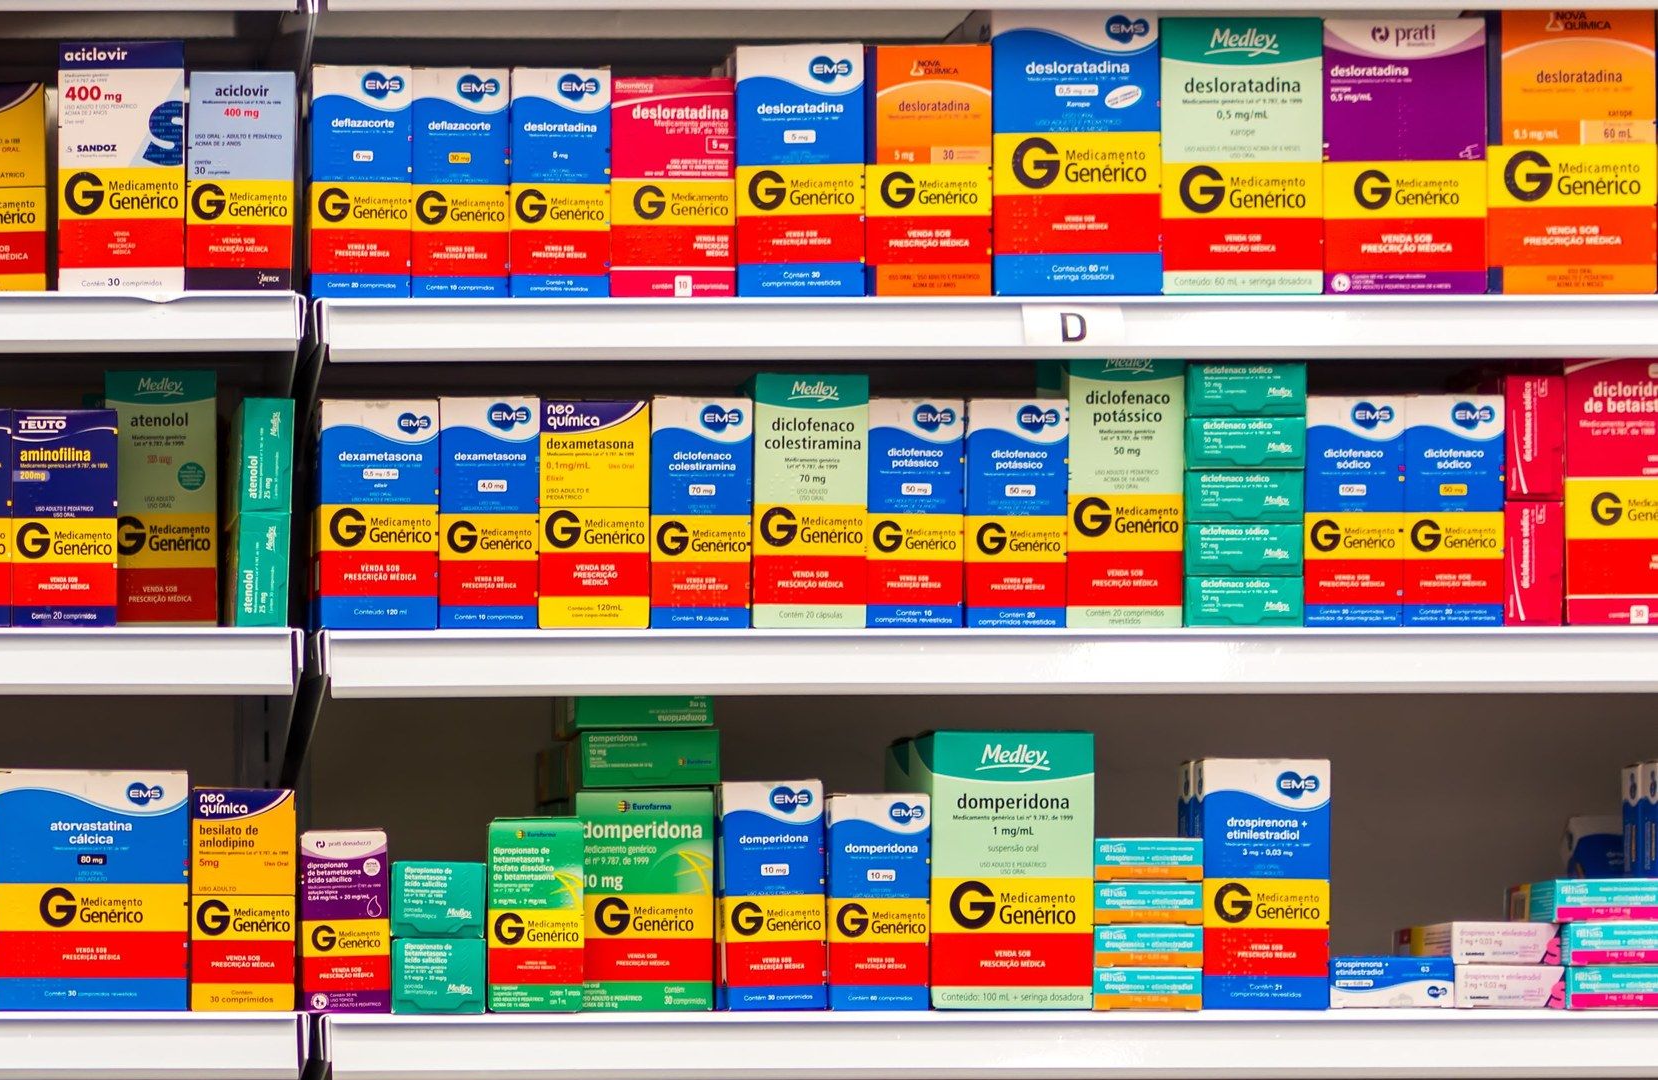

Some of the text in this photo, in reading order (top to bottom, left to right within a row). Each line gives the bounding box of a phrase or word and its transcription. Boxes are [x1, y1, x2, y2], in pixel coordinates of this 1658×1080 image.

[1395, 24, 1435, 47] prati
[918, 60, 941, 68] NOVA
[924, 66, 959, 75] QUÍMICA
[365, 79, 401, 91] EMS
[1184, 77, 1300, 93] desloratadina
[65, 85, 122, 103] 400 mg
[632, 105, 728, 119] desloratadina
[1216, 110, 1268, 122] 0,5 mg/mL
[331, 118, 395, 128] deflazacorte
[1603, 128, 1631, 140] 60 mL
[77, 144, 116, 152] SANDOZ
[919, 180, 977, 192] Medicamento
[918, 188, 978, 204] Genérico
[1060, 313, 1087, 342] D
[772, 417, 855, 432] diclofenaco
[1203, 421, 1273, 431] diclofenaco sódico
[764, 435, 861, 450] colestiramina
[1204, 436, 1214, 444] 50
[338, 451, 423, 461] dexametasona
[991, 449, 1047, 461] diclofenaco
[996, 461, 1043, 472] potássico
[20, 471, 46, 481] 200mg
[248, 456, 258, 499] atenolol
[481, 482, 504, 492] 4,0 mg
[957, 793, 1069, 813] domperidona
[199, 824, 258, 835] besilato de
[1227, 818, 1298, 832] drospirenona
[1226, 829, 1300, 842] etinilestradiol
[200, 835, 254, 849] anlodipino
[988, 844, 1039, 854] suspensão oral
[210, 994, 274, 1006] 30 comprimidos
